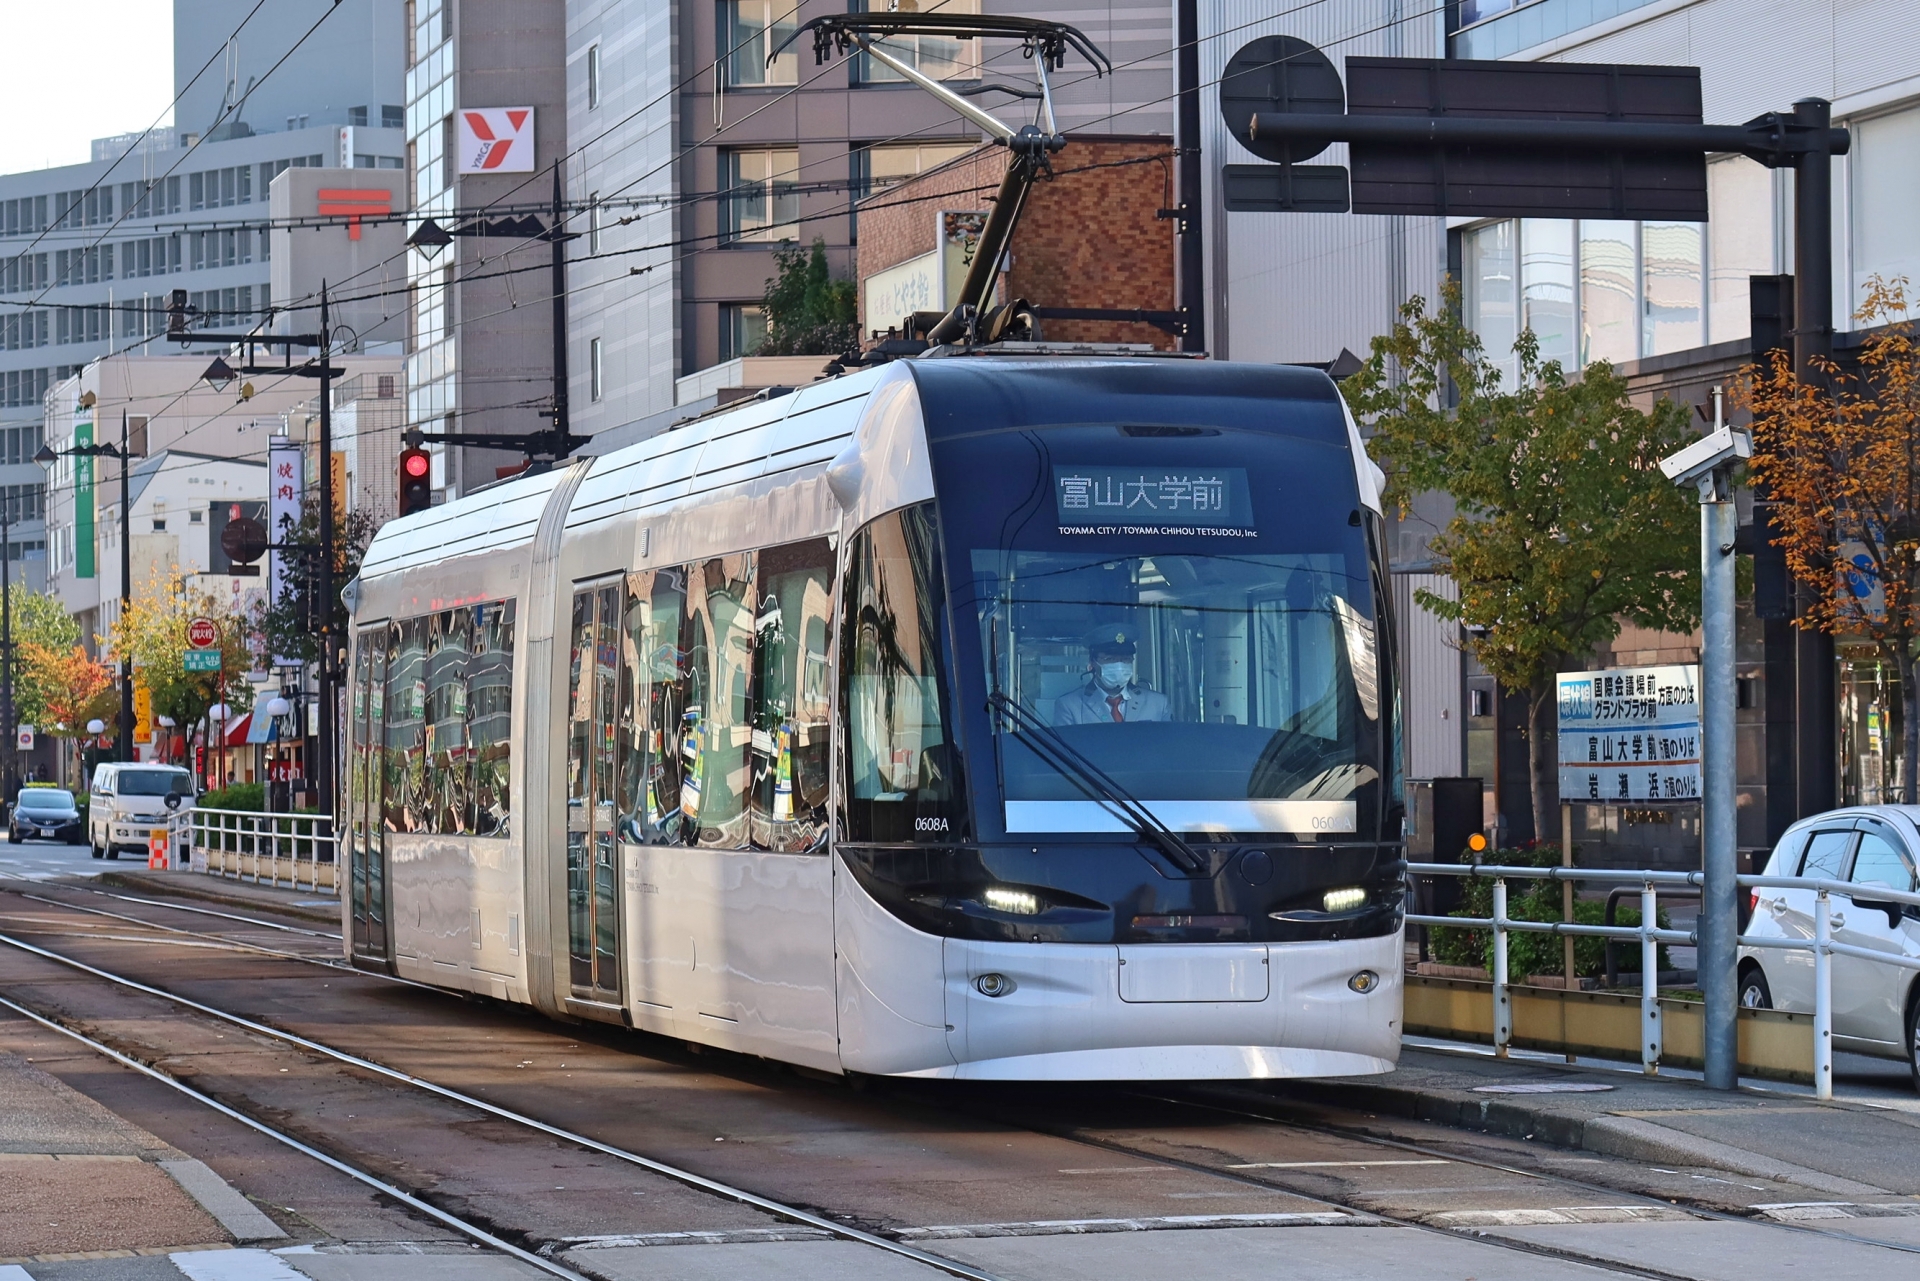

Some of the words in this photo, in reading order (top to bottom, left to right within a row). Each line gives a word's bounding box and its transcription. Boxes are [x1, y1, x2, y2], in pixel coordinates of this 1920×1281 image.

[471, 142, 491, 169] YMCA
[80, 437, 89, 493] ゆちょ銀行
[277, 462, 293, 500] 焼肉
[1060, 475, 1223, 510] 富山大学前
[1058, 526, 1096, 535] TOYAMA
[1097, 526, 1116, 535] CITY
[1123, 526, 1160, 535] TOYAMA
[1161, 527, 1195, 535] CHIHOU
[191, 628, 213, 640] 消火栓
[1594, 674, 1656, 698] 国際会議場前
[1658, 684, 1695, 707] 方面のりば
[1560, 685, 1592, 716] 環状線
[1595, 697, 1657, 720] グランドプラザ前
[1588, 734, 1657, 761] 富山大学前
[1659, 736, 1695, 760] 方面のりば
[1588, 772, 1659, 799] 岩瀬浜
[1664, 774, 1697, 798] 方面のりば
[915, 817, 949, 831] 0608A
